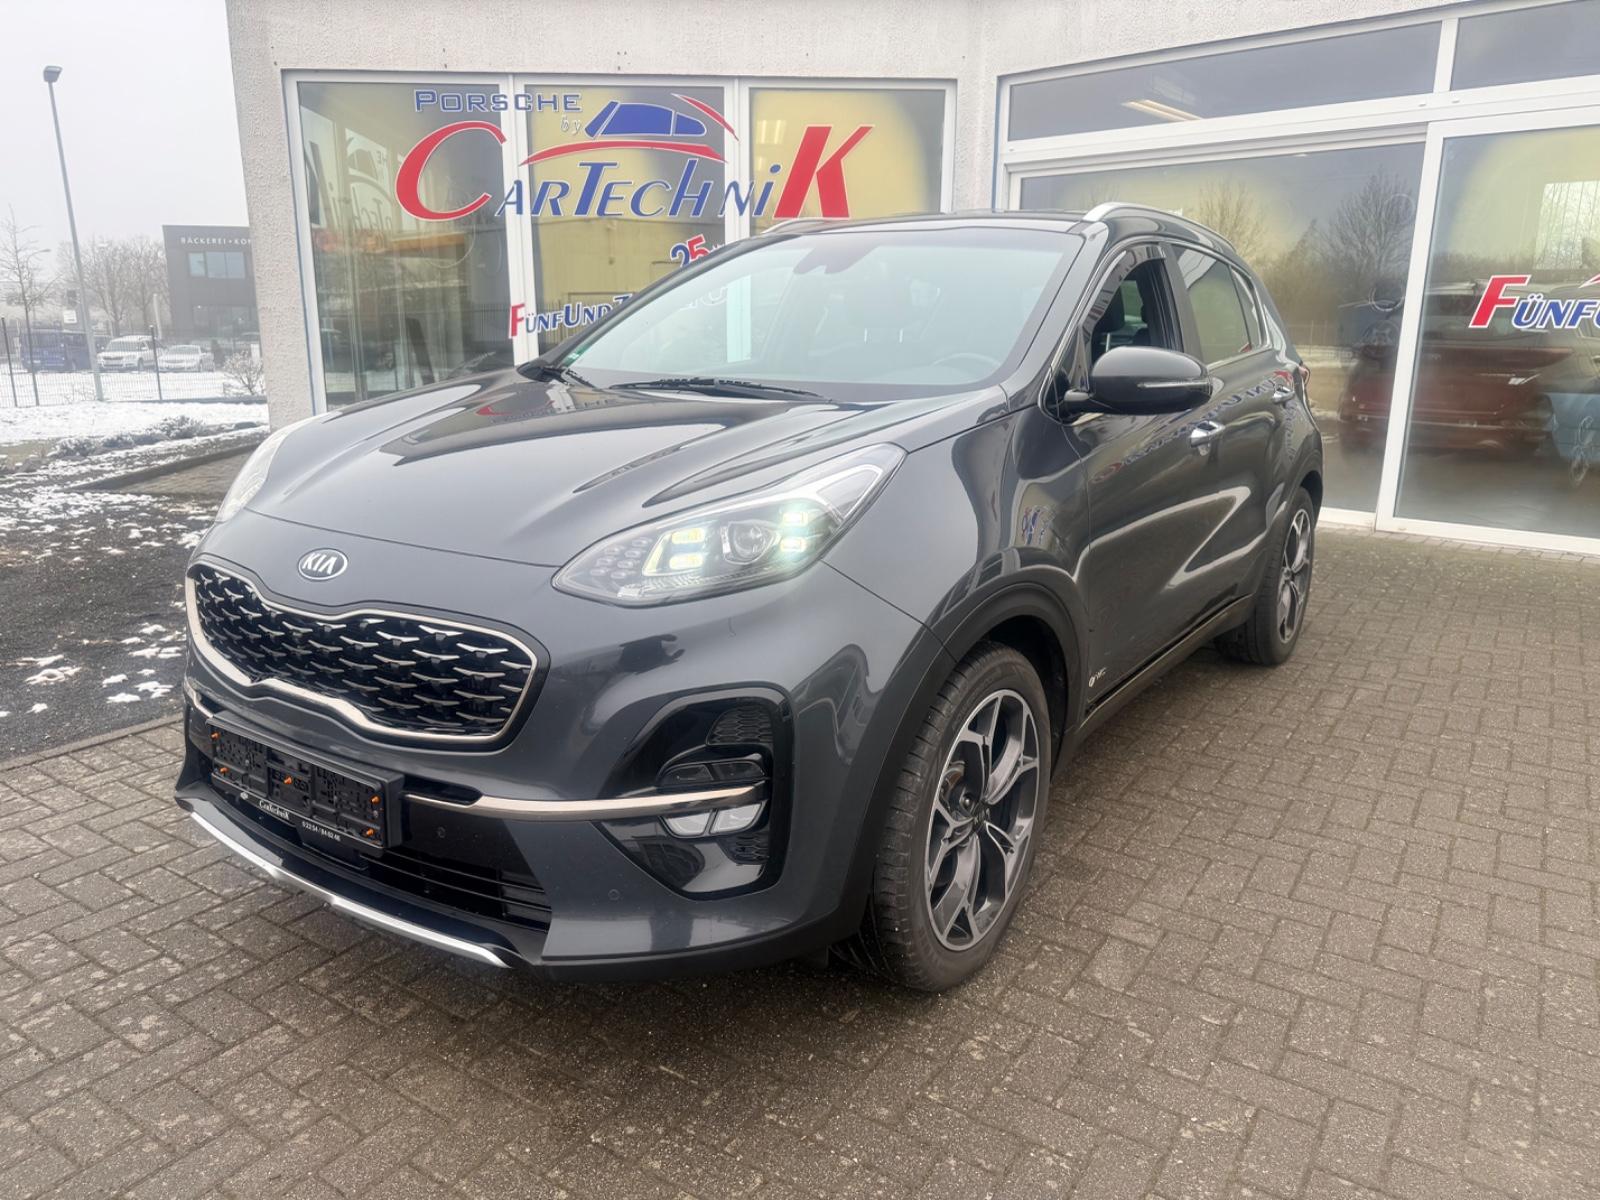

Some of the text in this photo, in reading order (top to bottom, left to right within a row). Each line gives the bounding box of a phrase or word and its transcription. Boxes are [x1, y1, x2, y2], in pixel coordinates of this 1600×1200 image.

[414, 89, 583, 113] PORSCHE
[561, 115, 582, 136] by
[1468, 274, 1600, 329] FÜNF
[301, 552, 339, 576] KIA
